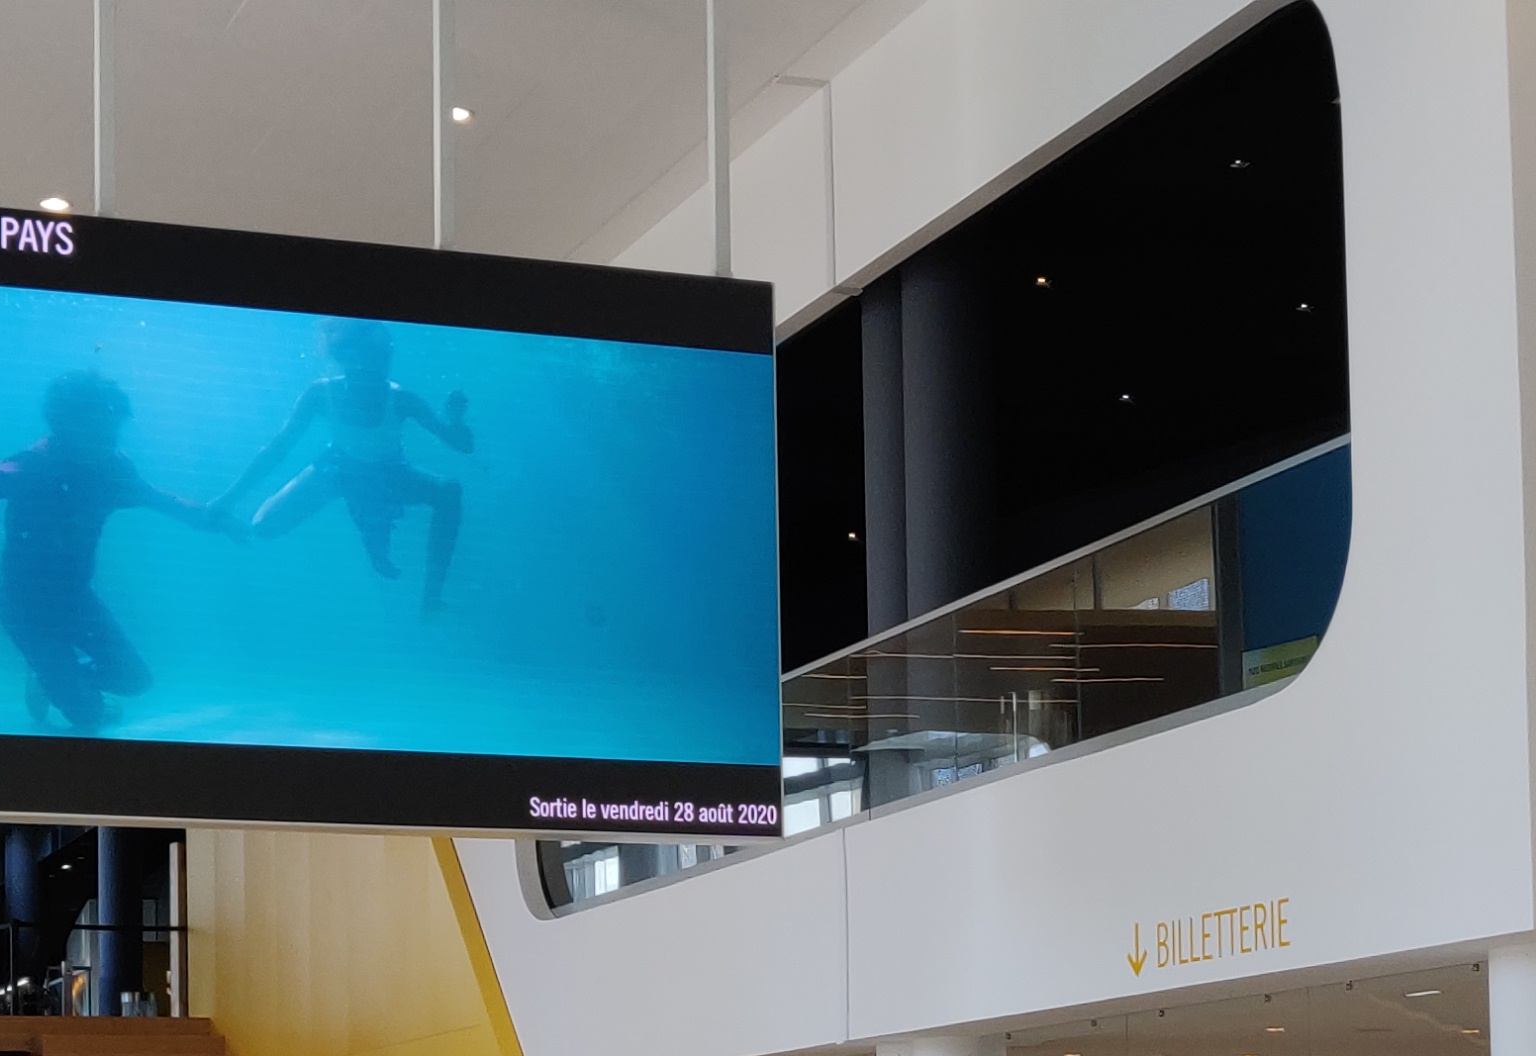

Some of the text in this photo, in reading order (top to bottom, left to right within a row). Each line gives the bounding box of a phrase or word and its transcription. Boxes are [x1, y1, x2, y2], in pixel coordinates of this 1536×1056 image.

[0, 216, 75, 256] PAYS
[529, 796, 778, 825] Sortie le vendredi 28 août 2020
[1156, 897, 1291, 969] BILLETTERIE
